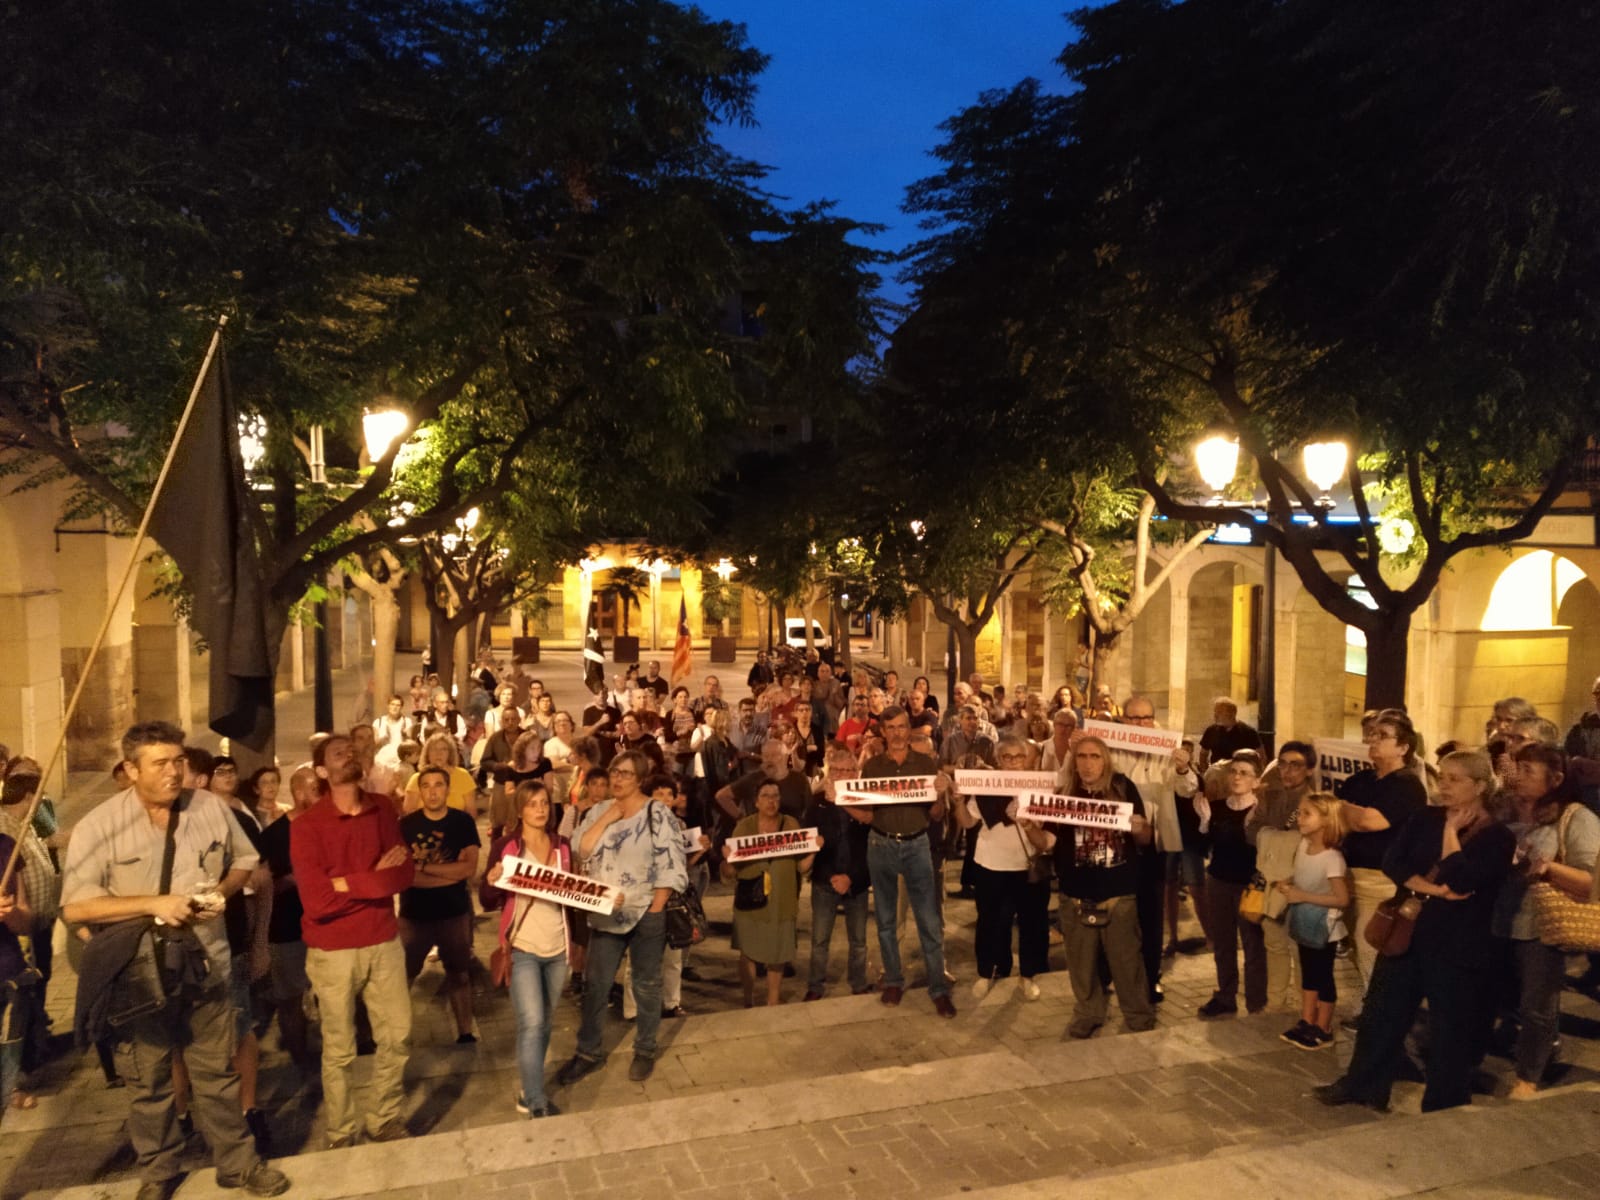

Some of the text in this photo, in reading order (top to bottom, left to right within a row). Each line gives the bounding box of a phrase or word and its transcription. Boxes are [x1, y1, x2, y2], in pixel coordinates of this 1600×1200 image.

[1110, 730, 1116, 741] A
[1117, 731, 1127, 742] LA
[846, 778, 928, 792] LLIBERTAT
[959, 776, 983, 787] JUDICI
[984, 778, 991, 788] A
[992, 778, 1002, 788] LA
[1030, 794, 1119, 815] LLIBERTAT
[737, 831, 808, 849] LLIBERTAT
[514, 862, 609, 898] LLIBERTAT
